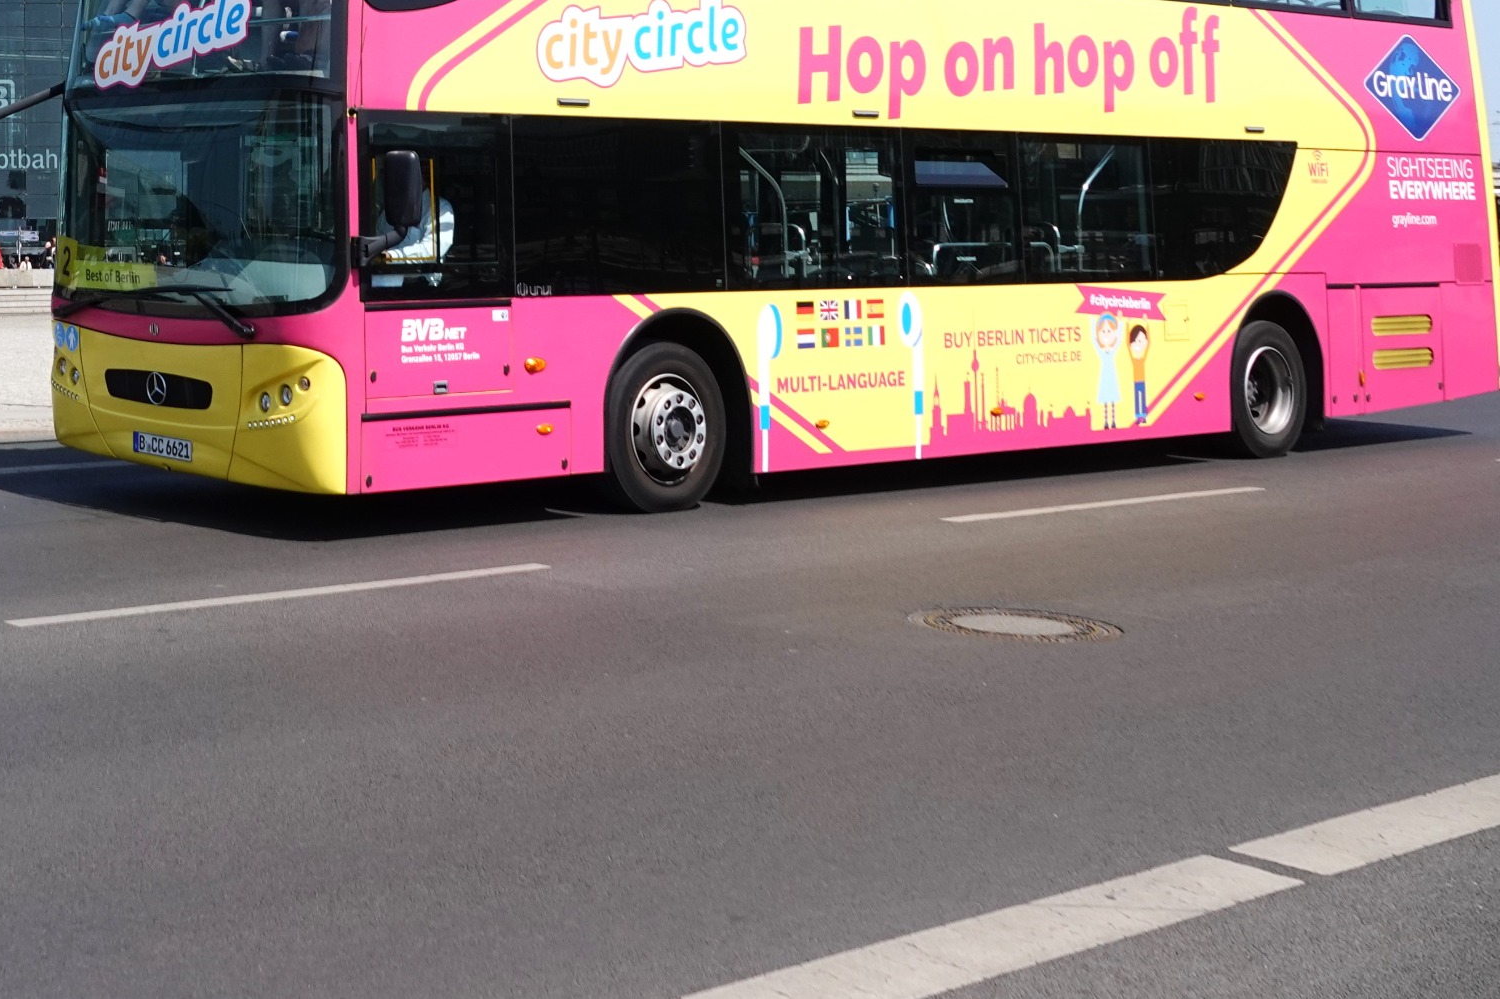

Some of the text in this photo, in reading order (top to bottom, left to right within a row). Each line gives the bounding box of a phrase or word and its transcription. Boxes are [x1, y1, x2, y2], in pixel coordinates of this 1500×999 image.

[545, 1, 740, 75] city circle
[99, 33, 152, 79] city
[798, 6, 1221, 120] Hop on hop off
[1308, 162, 1329, 177] WiFi
[1386, 156, 1474, 180] SIGHTSEEING
[1388, 181, 1476, 200] EVERYWHERE
[1392, 212, 1437, 228] grayline.com
[62, 246, 71, 277] 2
[85, 268, 140, 285] Best of Berlin
[1089, 293, 1152, 311] #citycircleberlin
[437, 343, 455, 352] Berlin
[943, 326, 1082, 349] BUY BERLIN TICKETS
[463, 351, 481, 361] Berlin
[776, 371, 906, 394] MULTI-LANGUAGE
[139, 434, 190, 459] B CC 6621
